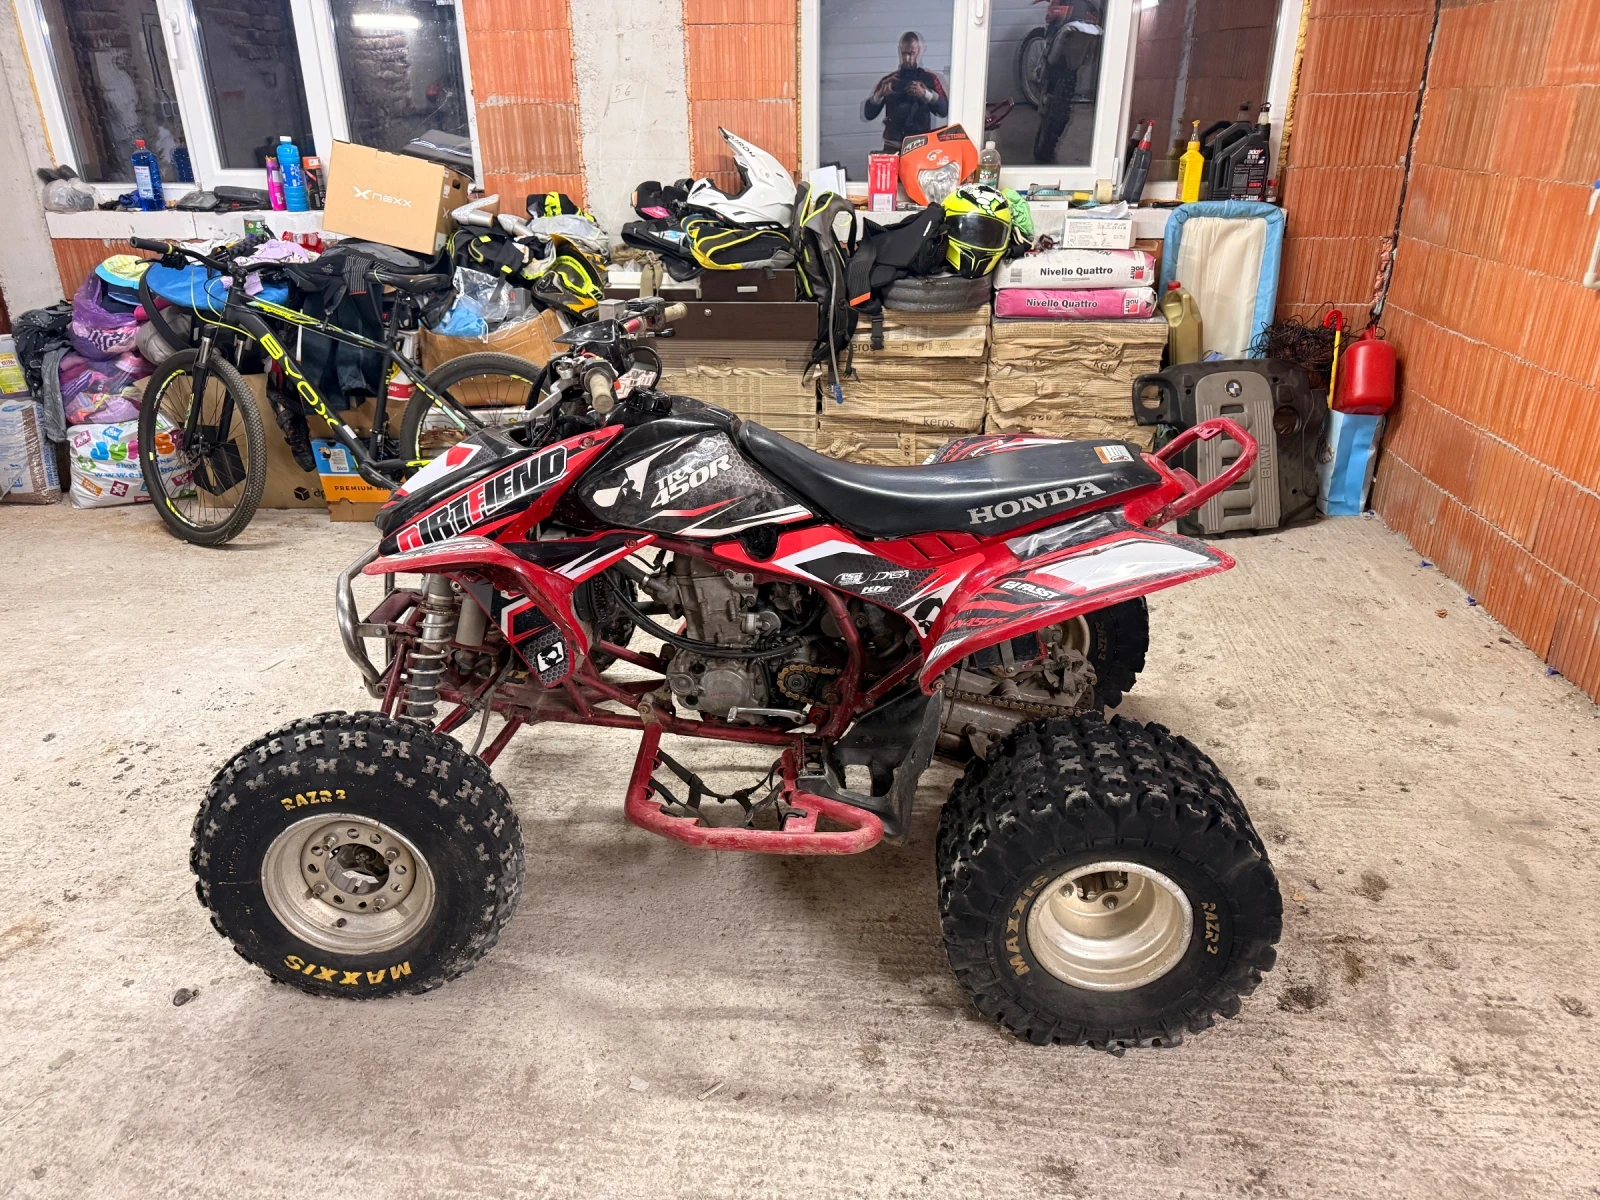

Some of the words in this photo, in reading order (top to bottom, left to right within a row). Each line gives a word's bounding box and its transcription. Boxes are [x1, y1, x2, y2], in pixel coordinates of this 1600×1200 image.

[1040, 268, 1073, 276] Nivello
[1076, 266, 1113, 276] Quattro
[1026, 298, 1059, 307] Nivello
[1061, 300, 1098, 308] Quattro
[259, 332, 339, 429] BYOX
[923, 416, 955, 428] keros
[654, 464, 695, 490] TRX
[1259, 444, 1272, 479] BMW
[650, 454, 733, 509] 450R
[966, 481, 1107, 525] HONDA
[1005, 875, 1049, 977] MAXXIS
[283, 954, 413, 985] MAXXIS
